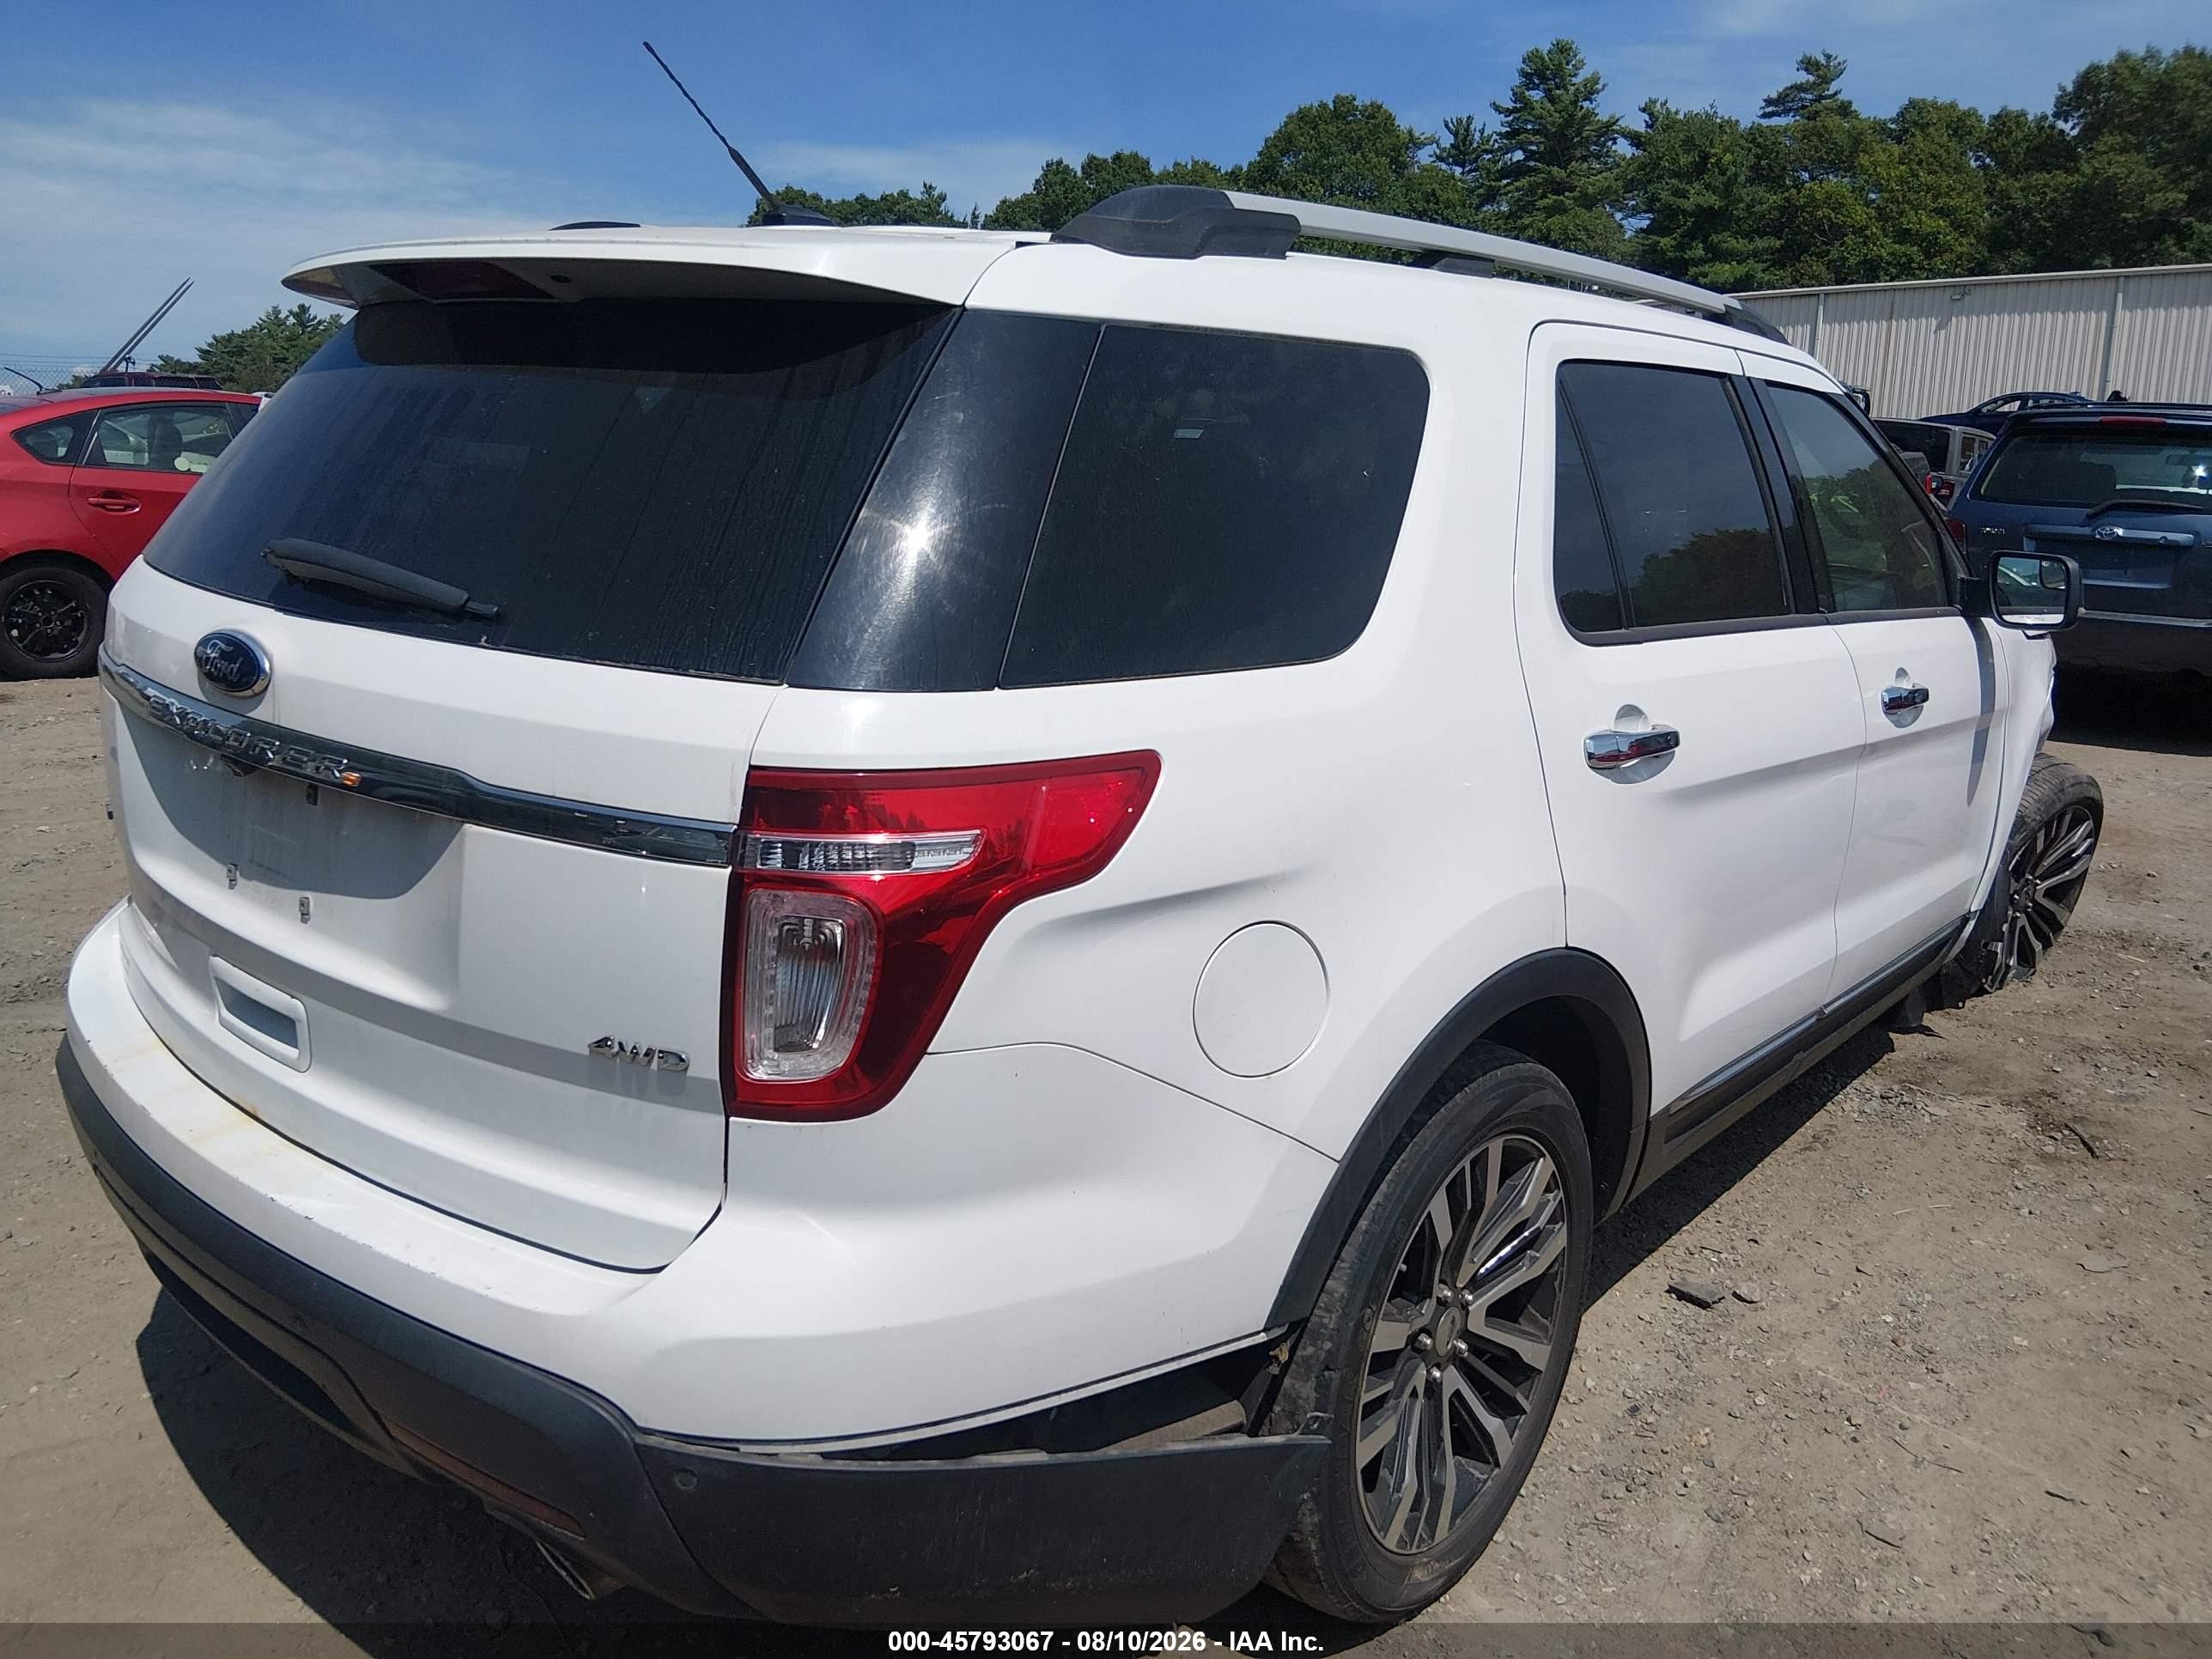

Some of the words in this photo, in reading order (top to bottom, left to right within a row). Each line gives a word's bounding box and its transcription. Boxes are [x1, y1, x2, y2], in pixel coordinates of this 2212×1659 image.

[201, 639, 243, 683] Ford
[149, 694, 349, 779] EXPLORER
[587, 1035, 690, 1073] 4WD
